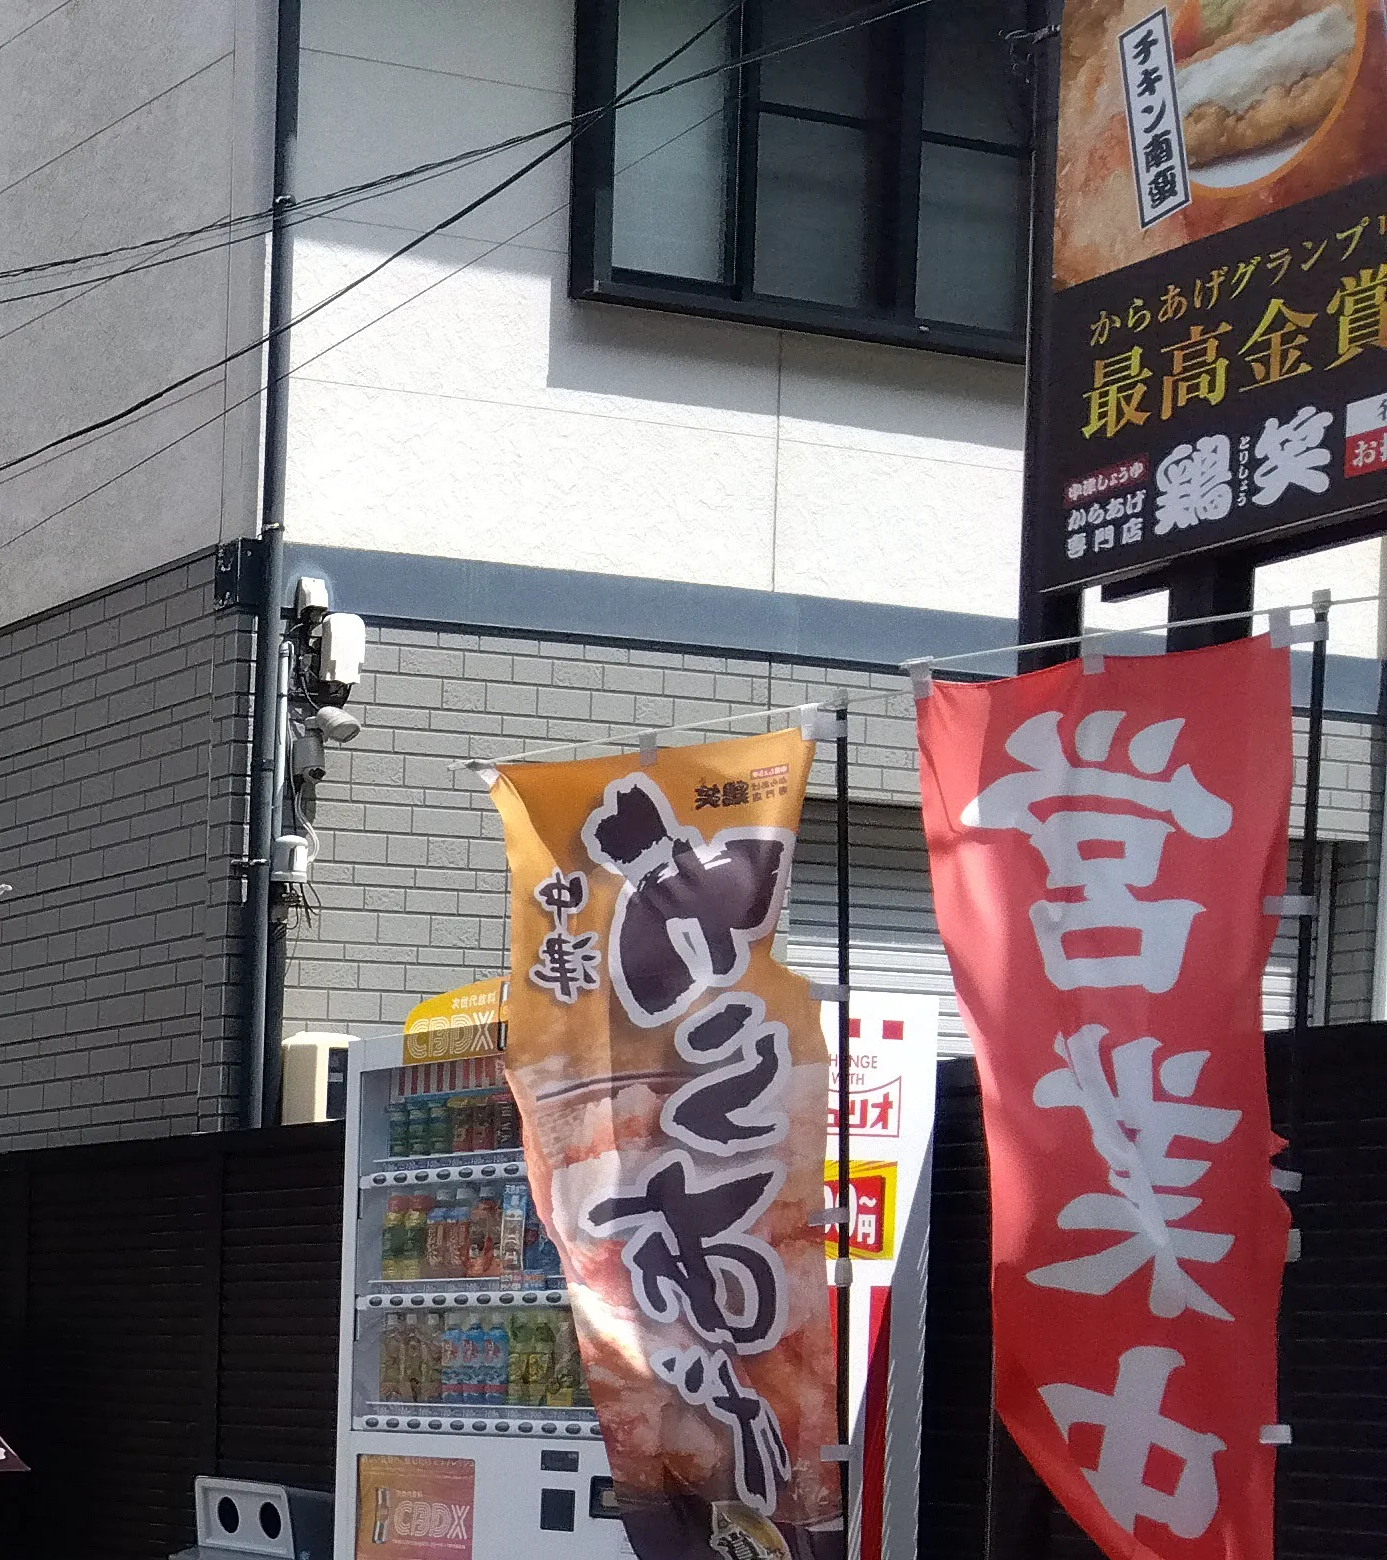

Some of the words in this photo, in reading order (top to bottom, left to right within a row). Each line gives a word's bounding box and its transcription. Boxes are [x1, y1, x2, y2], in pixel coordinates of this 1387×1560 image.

[1131, 30, 1178, 209] チキン南蛮
[1082, 262, 1387, 441] 最高金賞
[1155, 406, 1333, 535] 鶏笑
[1238, 436, 1251, 506] とりしょう
[1068, 490, 1147, 530] からあげ
[1067, 518, 1143, 559] 専門店
[407, 1010, 495, 1059] CBDX
[829, 1055, 878, 1068] HNGE
[832, 1073, 865, 1085] WTH
[394, 1501, 469, 1539] CBDX
